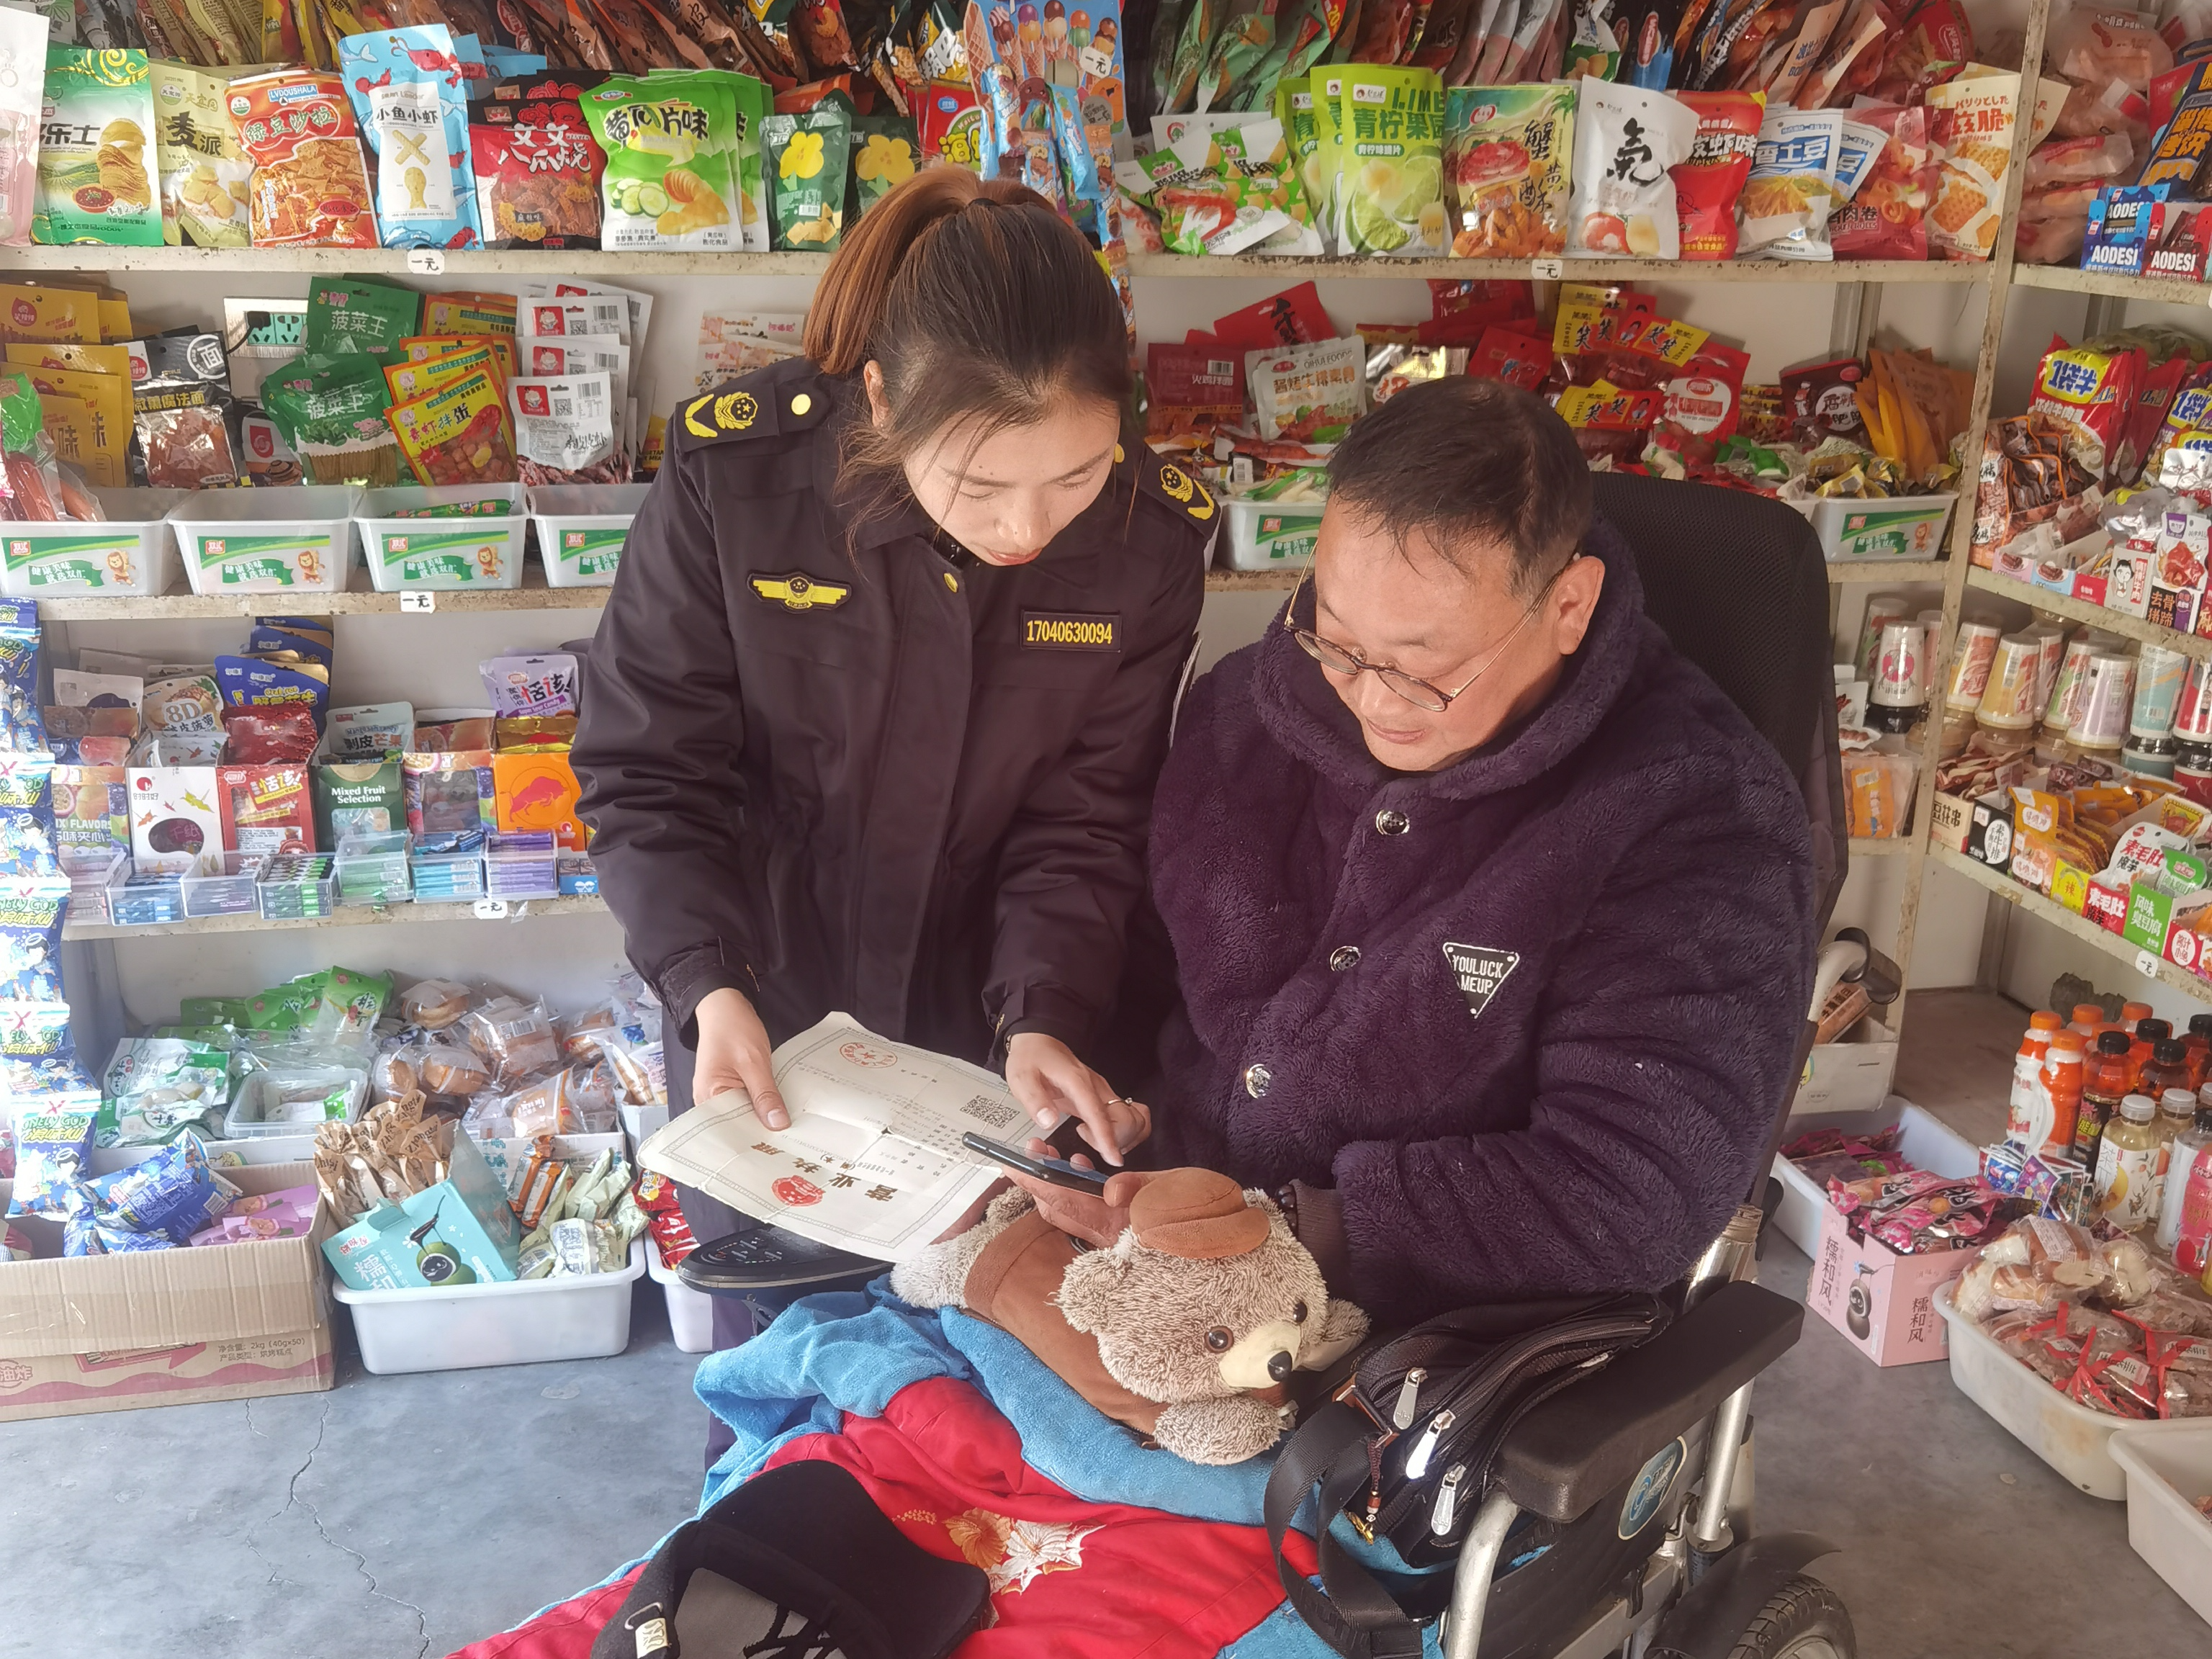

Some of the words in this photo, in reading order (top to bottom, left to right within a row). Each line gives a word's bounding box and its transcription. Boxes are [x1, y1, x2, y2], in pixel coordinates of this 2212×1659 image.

[1085, 55, 1107, 74] 一元
[269, 85, 317, 99] LVDOUSHALA
[245, 107, 336, 143] 绿豆沙拉
[377, 106, 439, 125] 小鱼小虾
[39, 122, 100, 146] 乐士
[166, 111, 222, 156] 麦派
[411, 258, 439, 271] 一元
[1536, 263, 1559, 279] 一元
[331, 310, 389, 338] 菠菜王
[402, 595, 431, 609] 一元
[1026, 620, 1113, 644] 17040630094
[343, 733, 403, 750] 剥皮芒果
[331, 786, 361, 796] Mixed
[363, 784, 386, 794] Fruit
[337, 794, 382, 804] Selection
[2121, 840, 2164, 867] 素毛肚
[480, 902, 503, 913] 一元
[2133, 894, 2155, 918] 风味
[1452, 954, 1504, 979] YOULUCK
[2140, 960, 2154, 975] 一元
[1461, 974, 1494, 994] MEUP
[60, 1115, 88, 1127] GOD
[24, 1127, 83, 1141] 浪味仙
[750, 1141, 899, 1202] 营业执照
[1819, 1235, 1839, 1306] 糯和风
[1907, 1296, 1929, 1344] 糯和风
